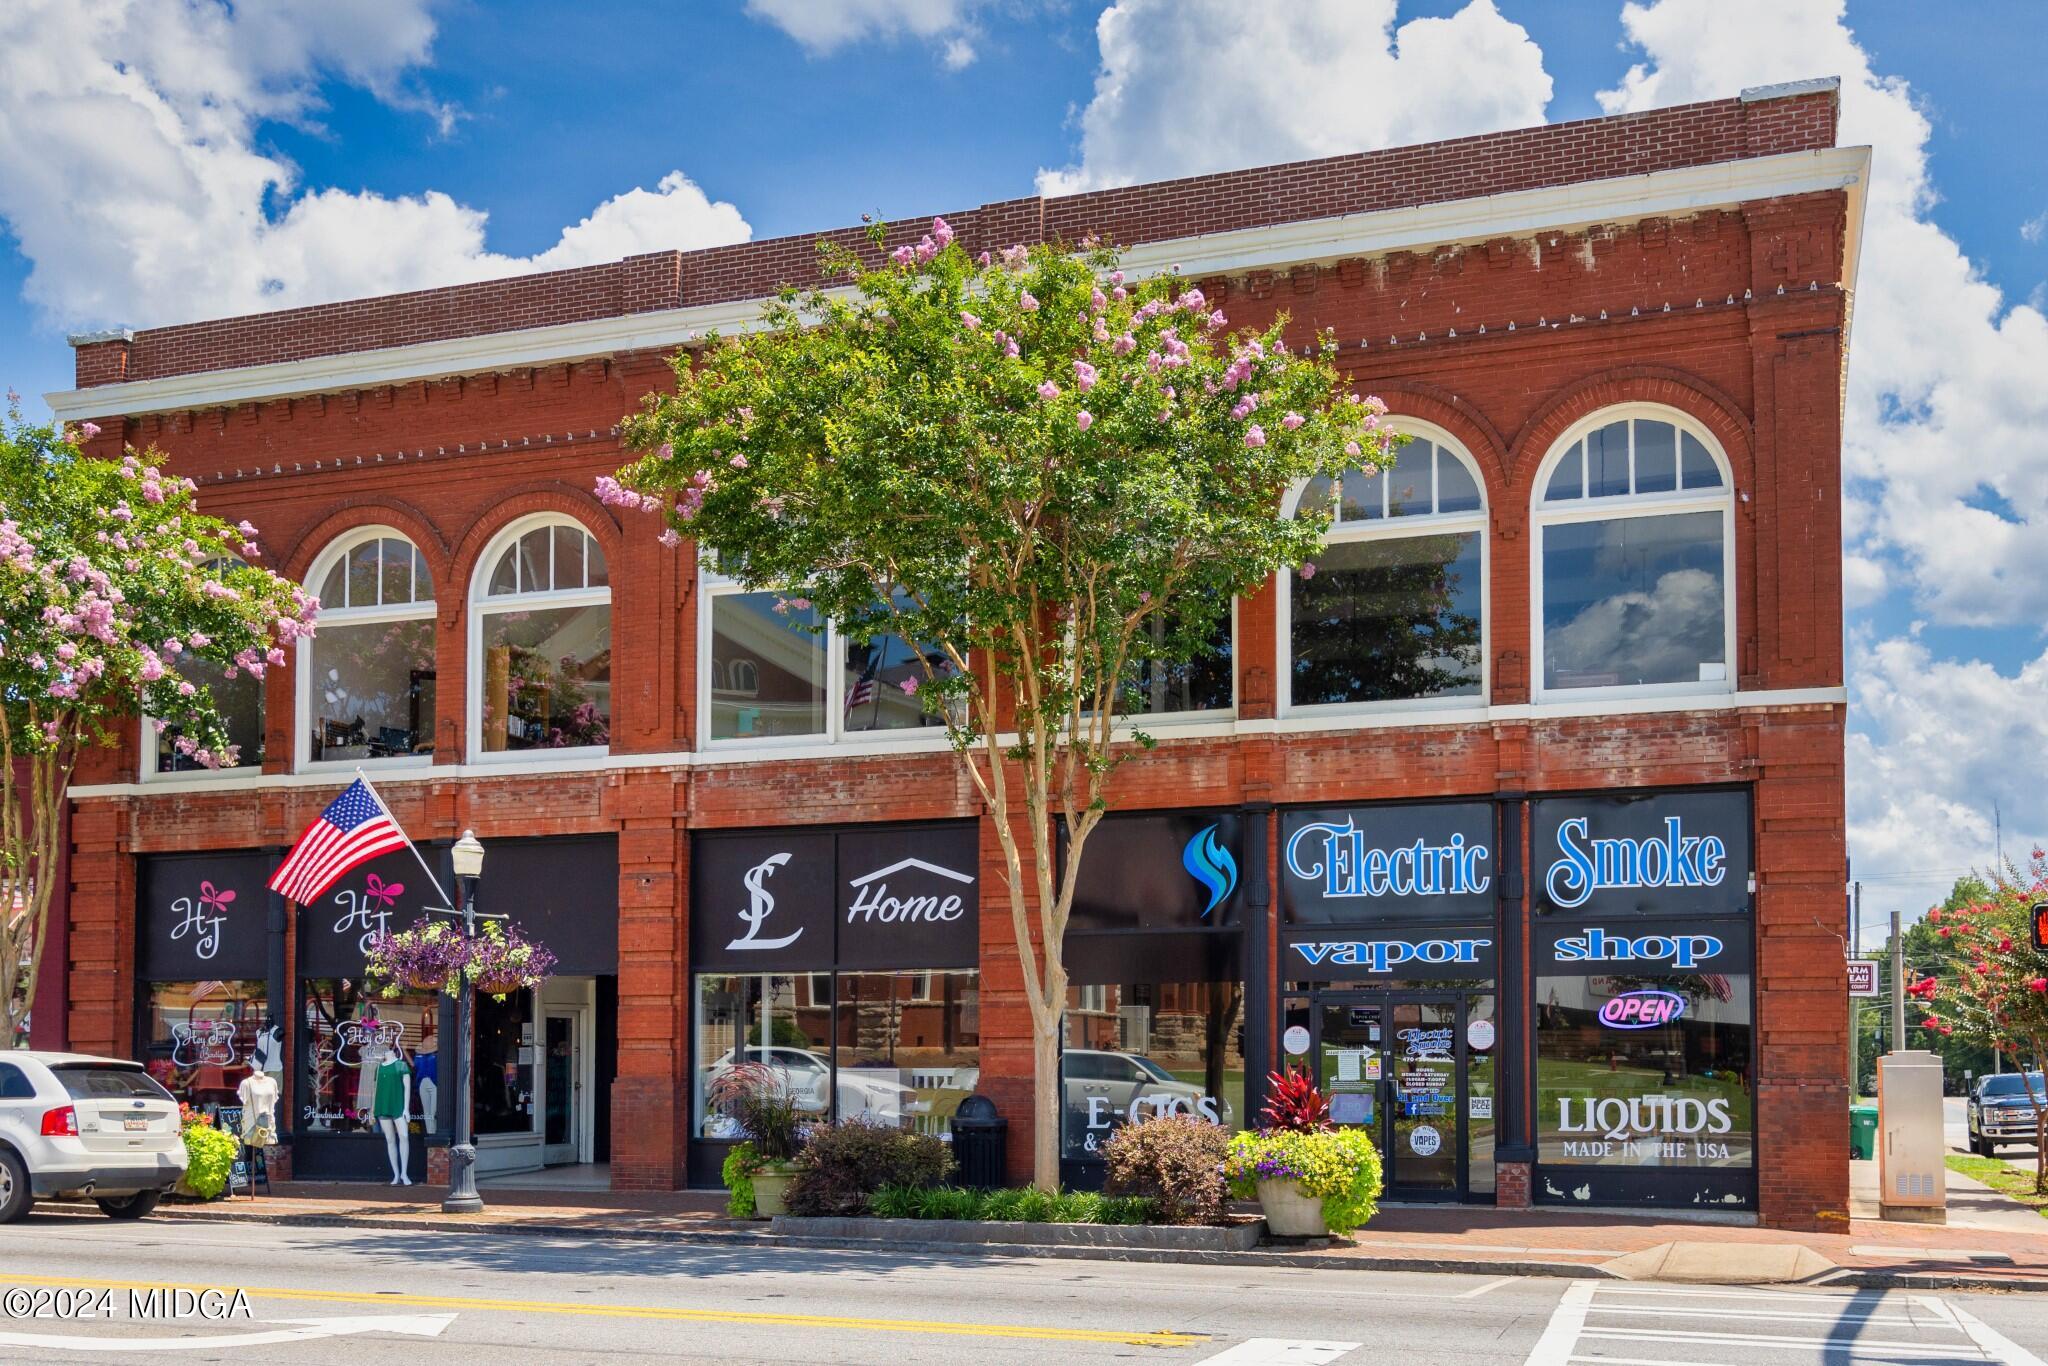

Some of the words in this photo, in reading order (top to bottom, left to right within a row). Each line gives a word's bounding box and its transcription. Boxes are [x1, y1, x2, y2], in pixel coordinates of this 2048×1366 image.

[1286, 813, 1490, 898] Electric
[1546, 816, 1726, 908] Smoke
[847, 883, 964, 923] Home
[1290, 939, 1492, 972] vapor
[1554, 928, 1723, 968] shop
[1847, 966, 1869, 974] ARM
[1849, 974, 1869, 982] EAU
[1604, 998, 1675, 1023] OPEN
[304, 1105, 345, 1119] Handmade
[1558, 1097, 1732, 1141] LIQUIDS
[1083, 1132, 1098, 1151] &
[1563, 1141, 1614, 1157] MADE
[1623, 1142, 1641, 1158] IN
[1650, 1143, 1686, 1158] THE
[1697, 1143, 1730, 1159] USA
